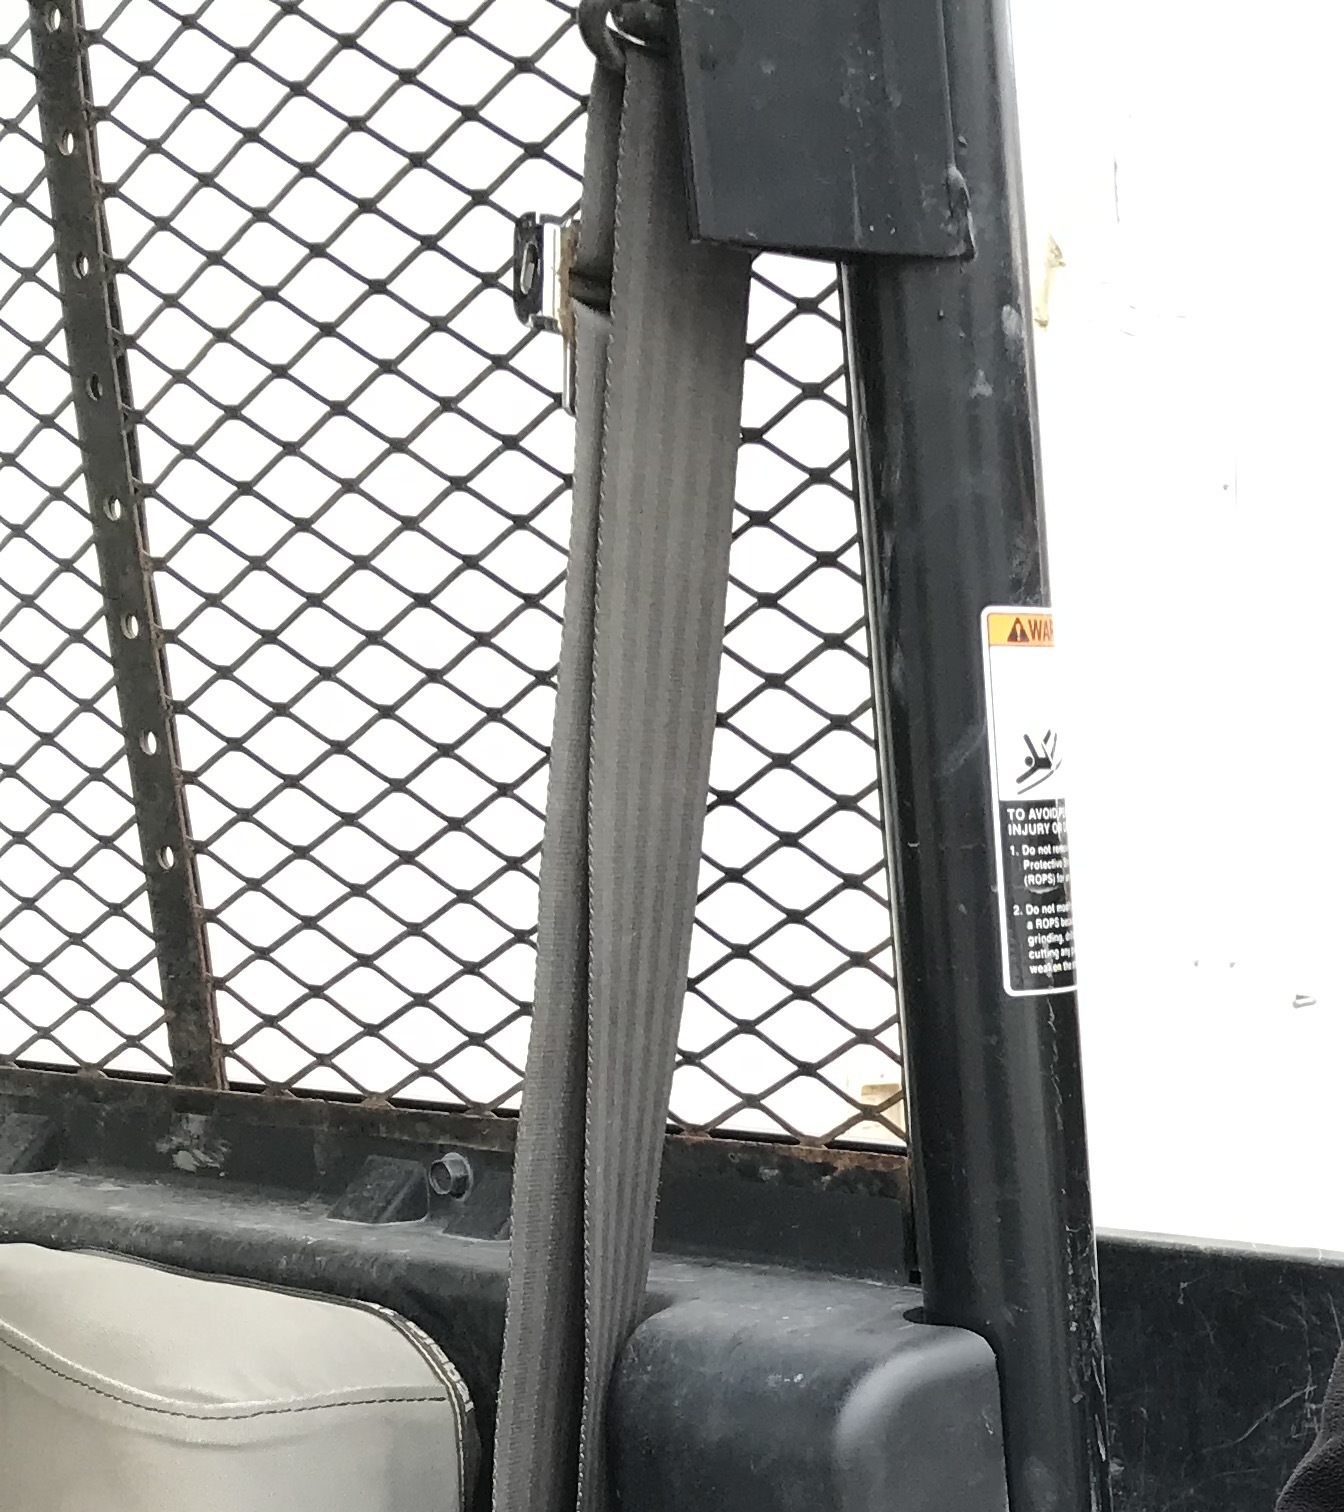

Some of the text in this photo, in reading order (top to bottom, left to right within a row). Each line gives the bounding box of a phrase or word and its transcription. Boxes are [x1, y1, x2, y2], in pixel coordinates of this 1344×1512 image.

[1007, 808, 1025, 820] TO
[1029, 807, 1057, 820] AVOID
[1008, 823, 1050, 835] INJURY
[1010, 845, 1019, 857] 1.
[1022, 844, 1035, 856] Do
[1038, 844, 1052, 855] not
[1024, 872, 1056, 887] (ROPS)
[1013, 904, 1023, 916] 2.
[1026, 903, 1040, 915] Do
[1042, 903, 1055, 914] not
[1036, 917, 1060, 929] ROPS
